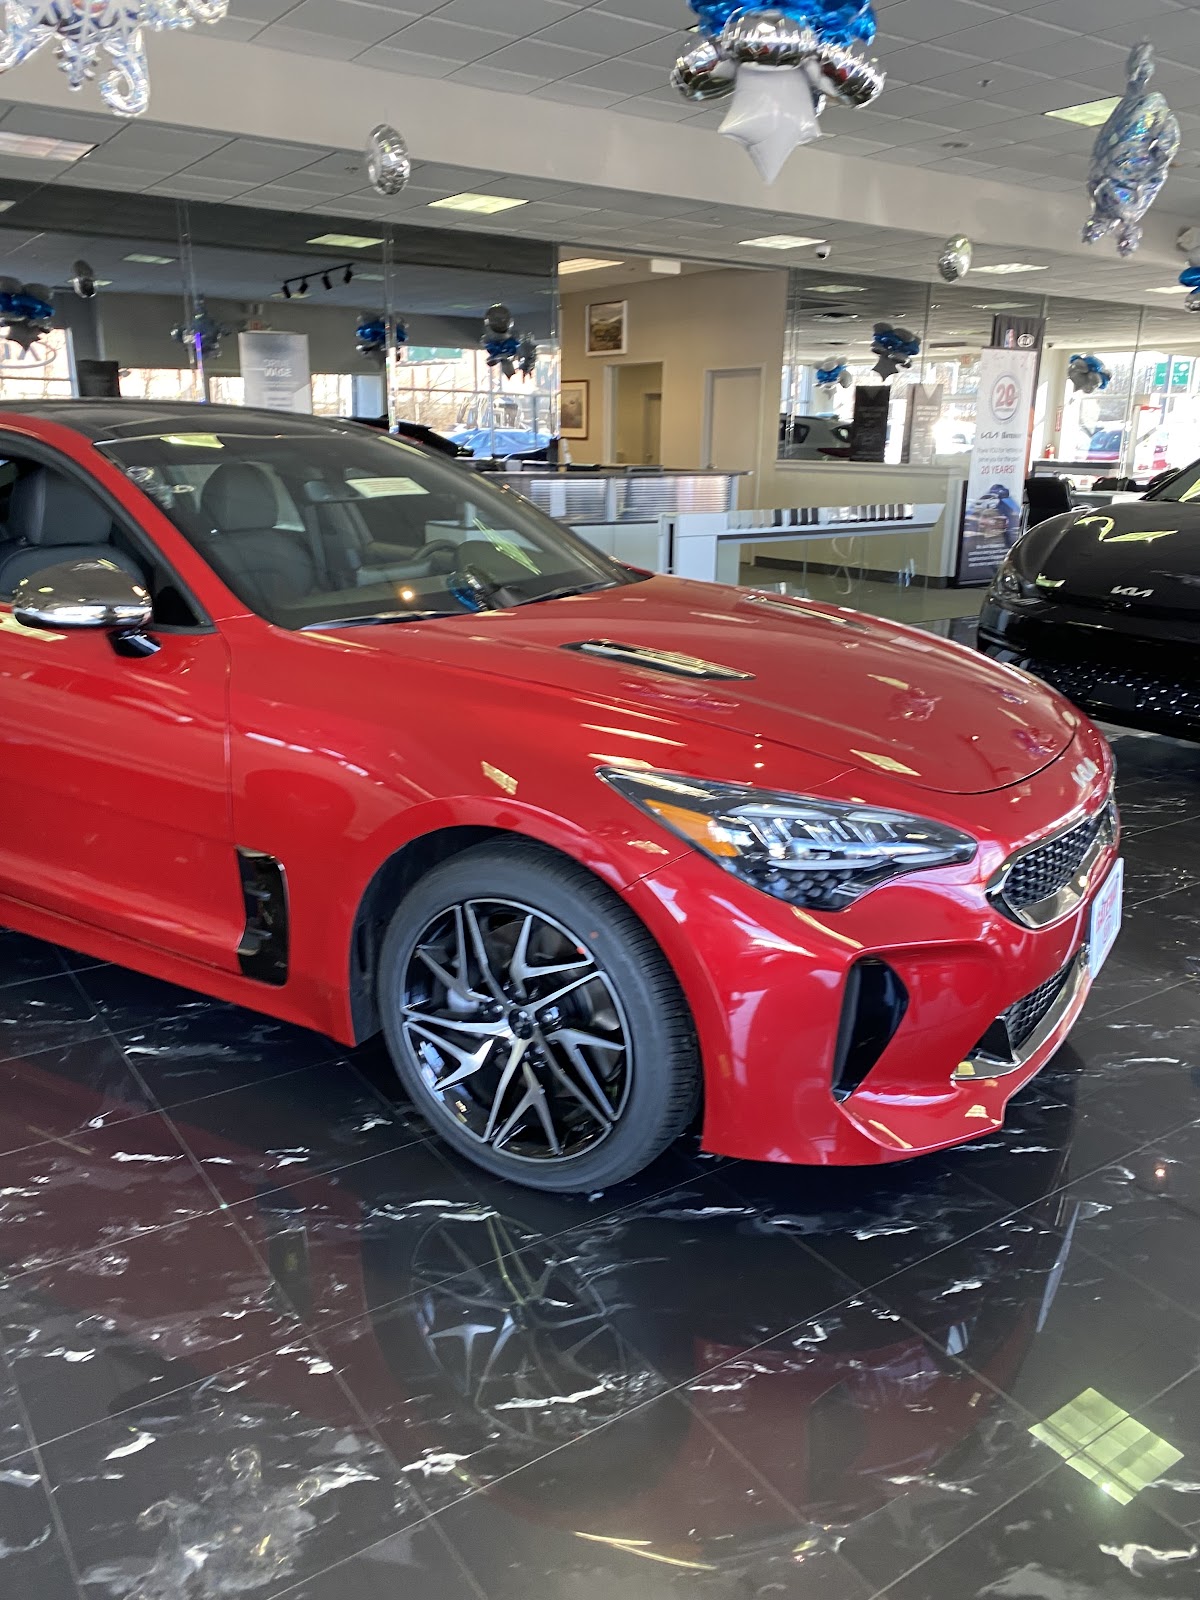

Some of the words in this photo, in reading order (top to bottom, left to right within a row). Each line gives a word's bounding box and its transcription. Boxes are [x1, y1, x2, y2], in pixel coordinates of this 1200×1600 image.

[995, 384, 1018, 407] 20
[980, 431, 999, 439] KIA
[981, 465, 990, 475] 20
[992, 464, 1015, 474] YEARS!
[1110, 585, 1155, 598] KIA
